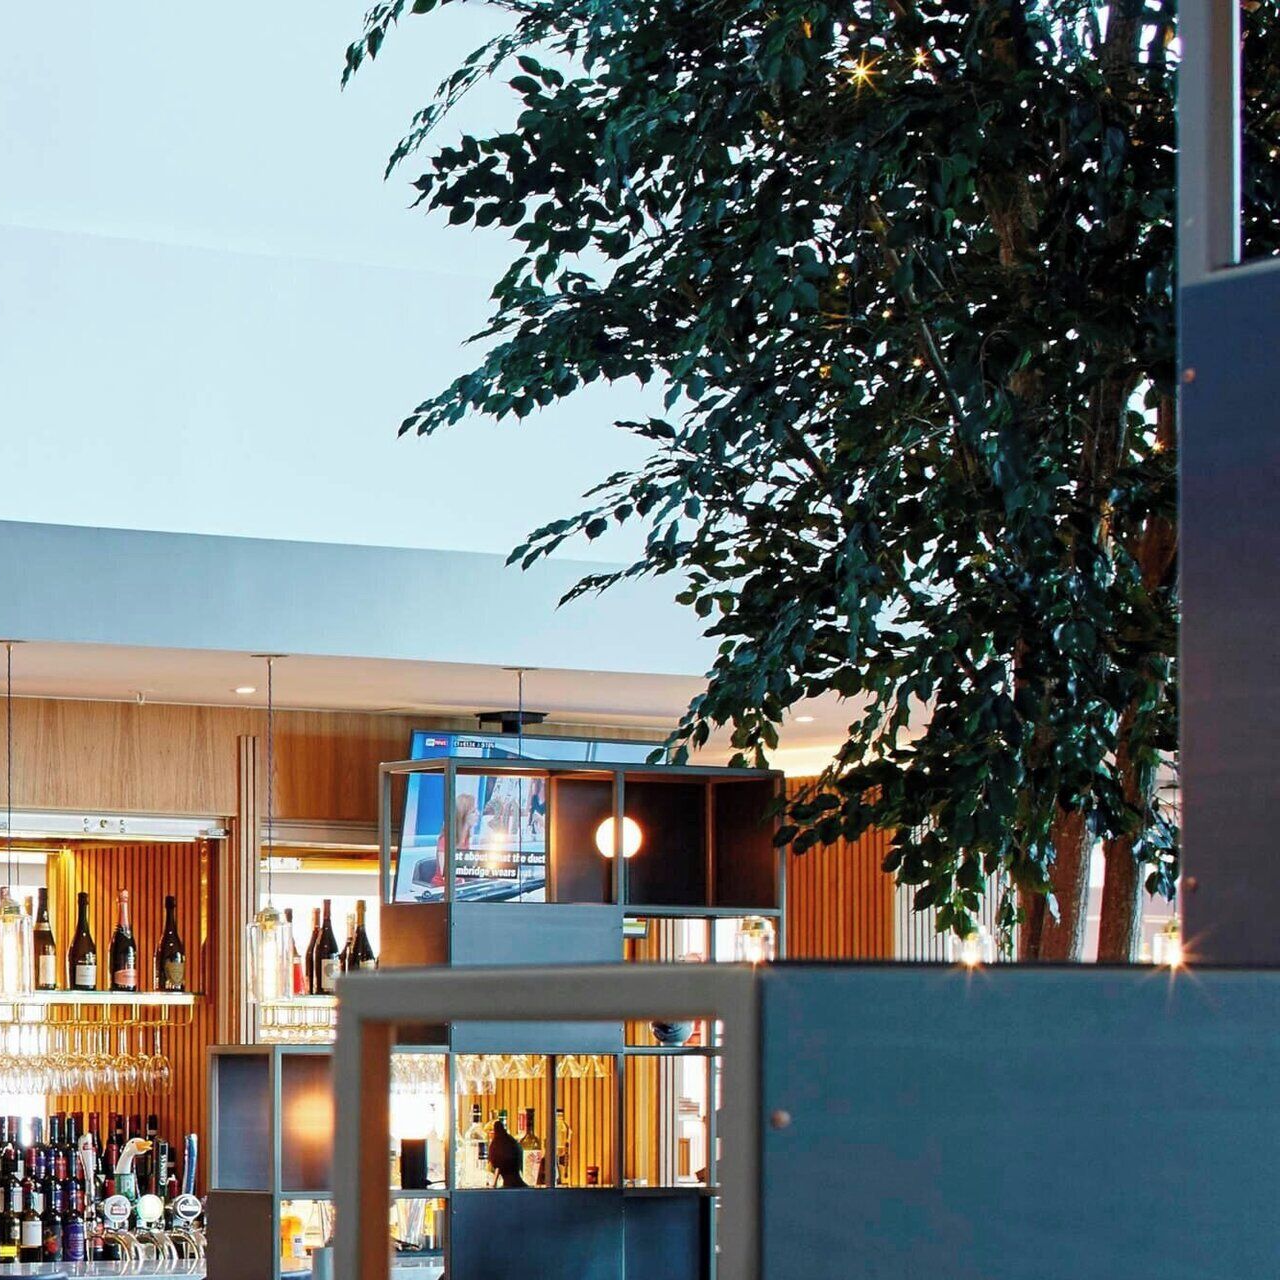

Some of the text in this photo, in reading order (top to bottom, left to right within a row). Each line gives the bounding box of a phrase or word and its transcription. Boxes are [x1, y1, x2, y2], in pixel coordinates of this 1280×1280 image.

[455, 852, 463, 861] st
[527, 854, 546, 864] duct
[455, 866, 488, 877] mbridge
